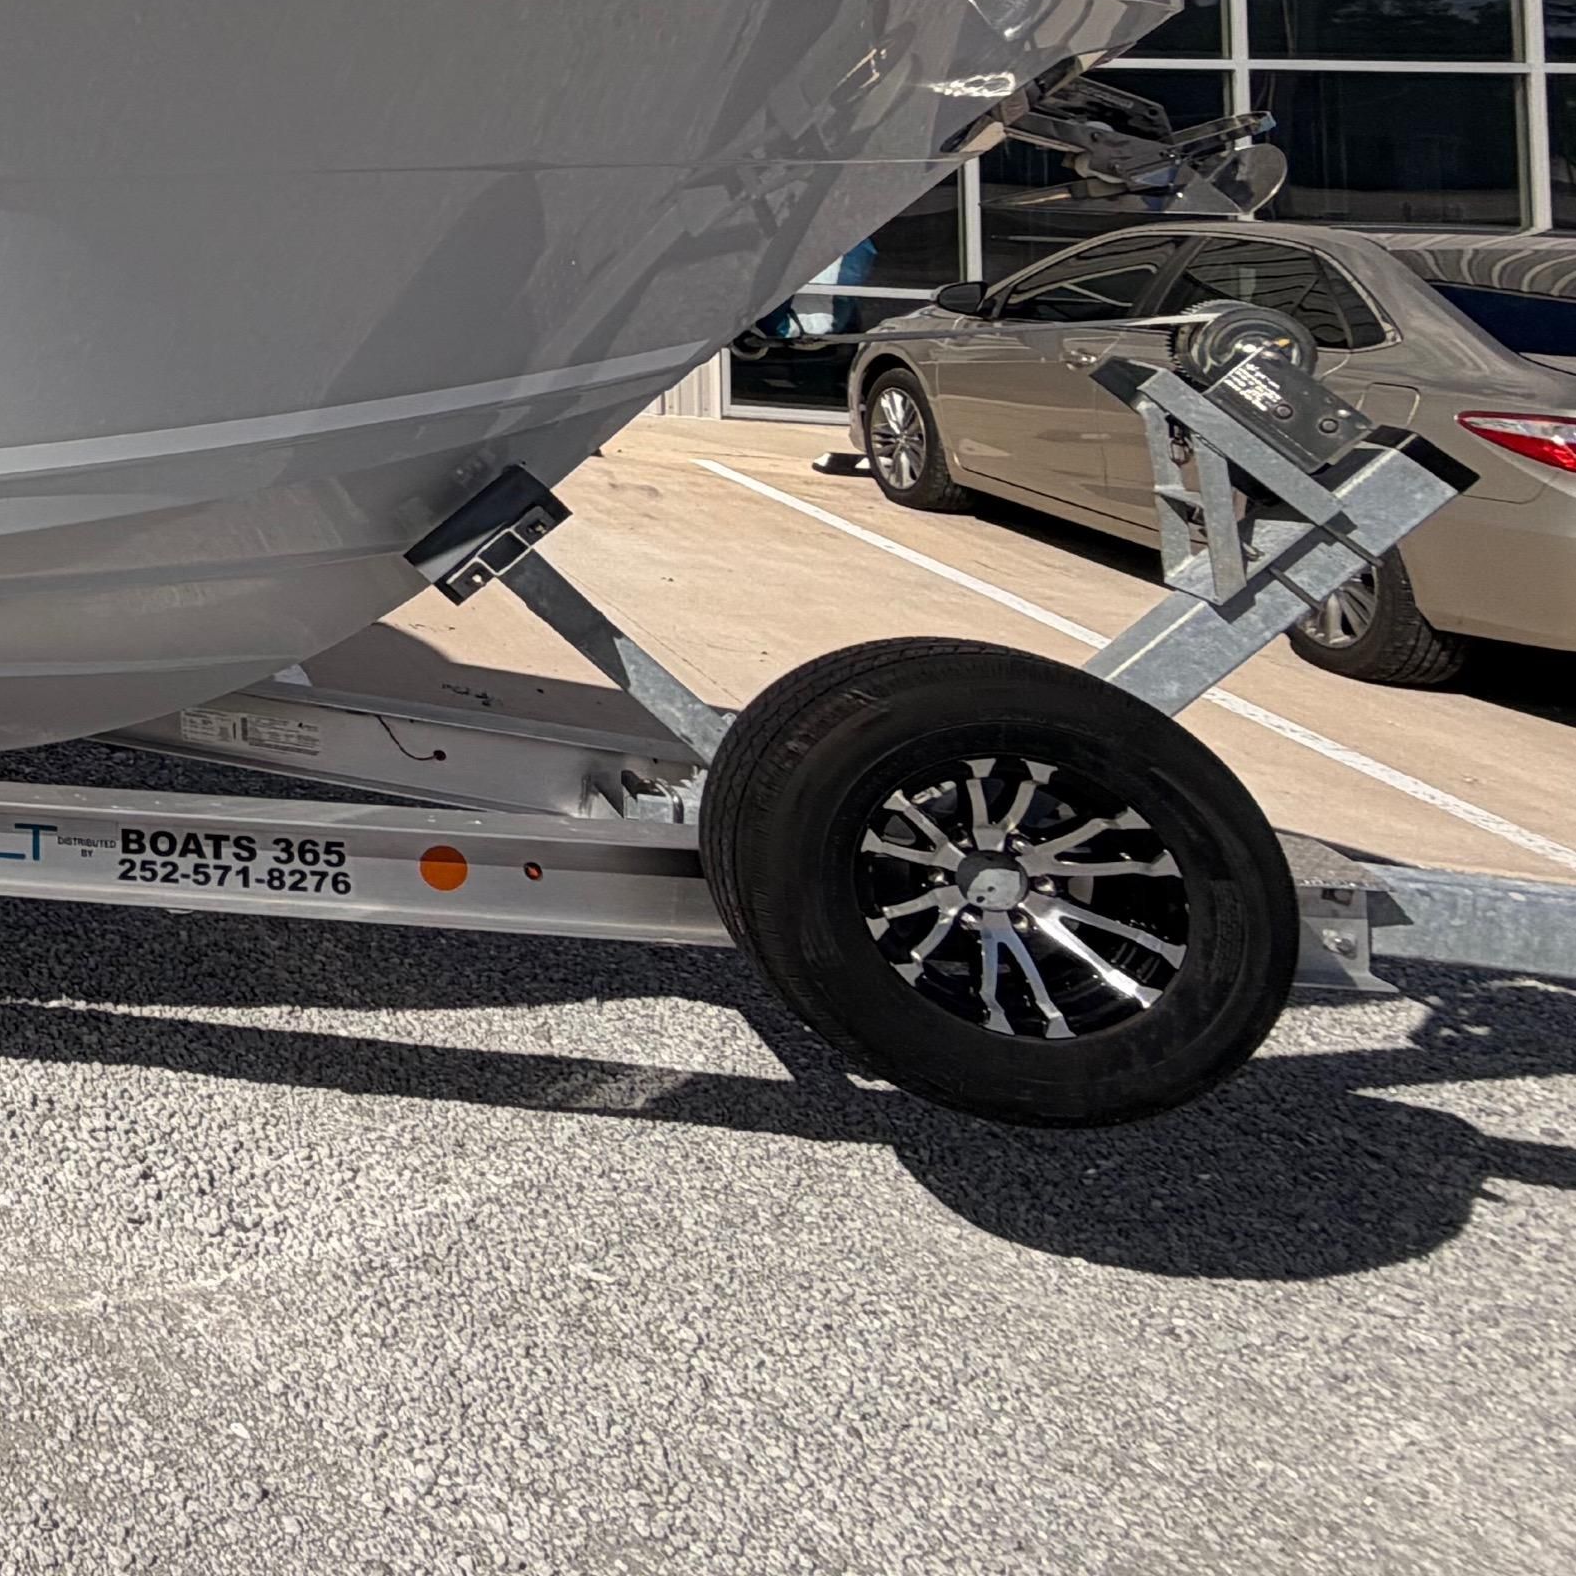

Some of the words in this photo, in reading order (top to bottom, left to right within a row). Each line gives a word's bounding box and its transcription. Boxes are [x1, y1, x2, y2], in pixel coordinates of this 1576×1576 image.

[58, 837, 116, 848] DISTRIBUTED
[82, 849, 93, 858] BY
[121, 828, 257, 862] BOATS
[272, 838, 346, 867] 365
[118, 858, 352, 895] 252-571-8276
